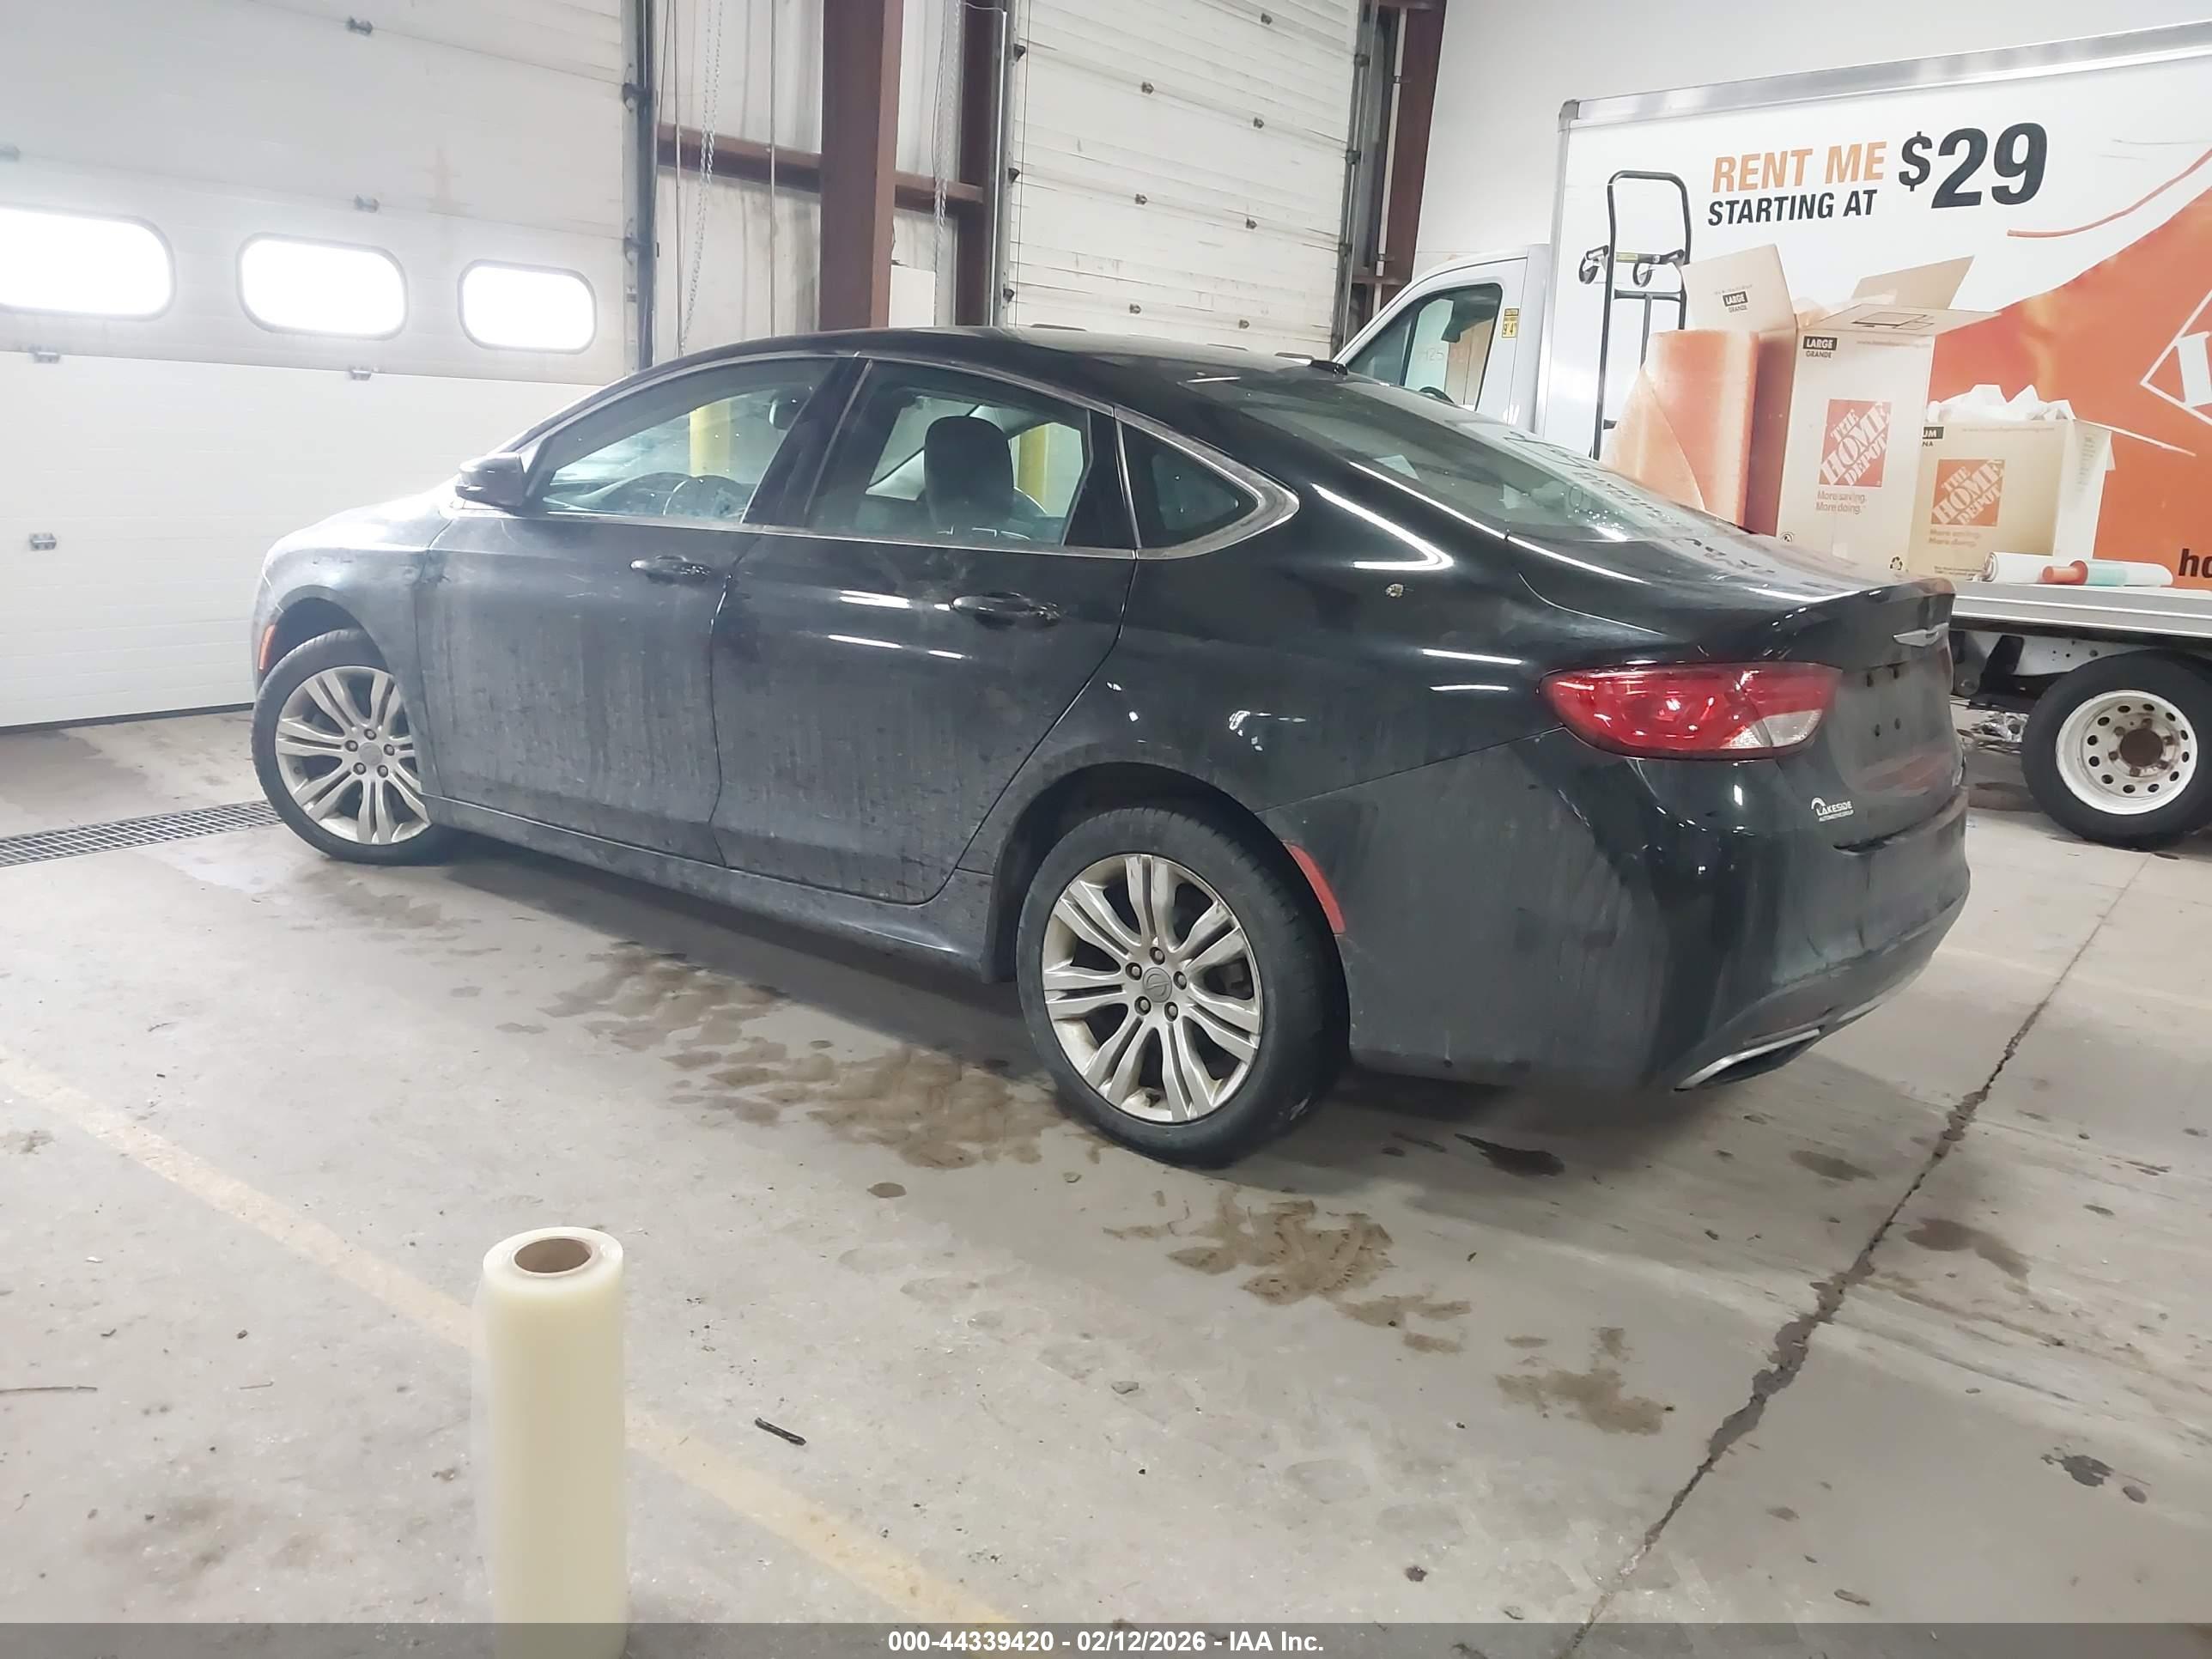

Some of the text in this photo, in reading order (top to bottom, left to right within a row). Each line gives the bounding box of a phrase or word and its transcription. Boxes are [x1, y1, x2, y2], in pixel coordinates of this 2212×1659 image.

[1712, 141, 1887, 193] RENT ME
[1898, 122, 2048, 210] $29
[1707, 189, 1879, 227] STARTING AT
[1806, 338, 1834, 349] LARGE
[1806, 350, 1832, 359] GRANDE
[1820, 403, 1889, 485] HOME
[1830, 408, 1860, 442] THE
[1844, 432, 1887, 486] DEPOT
[1941, 466, 1971, 493] THE
[1932, 460, 2003, 525] HOME
[1956, 483, 2002, 525] DEPOT
